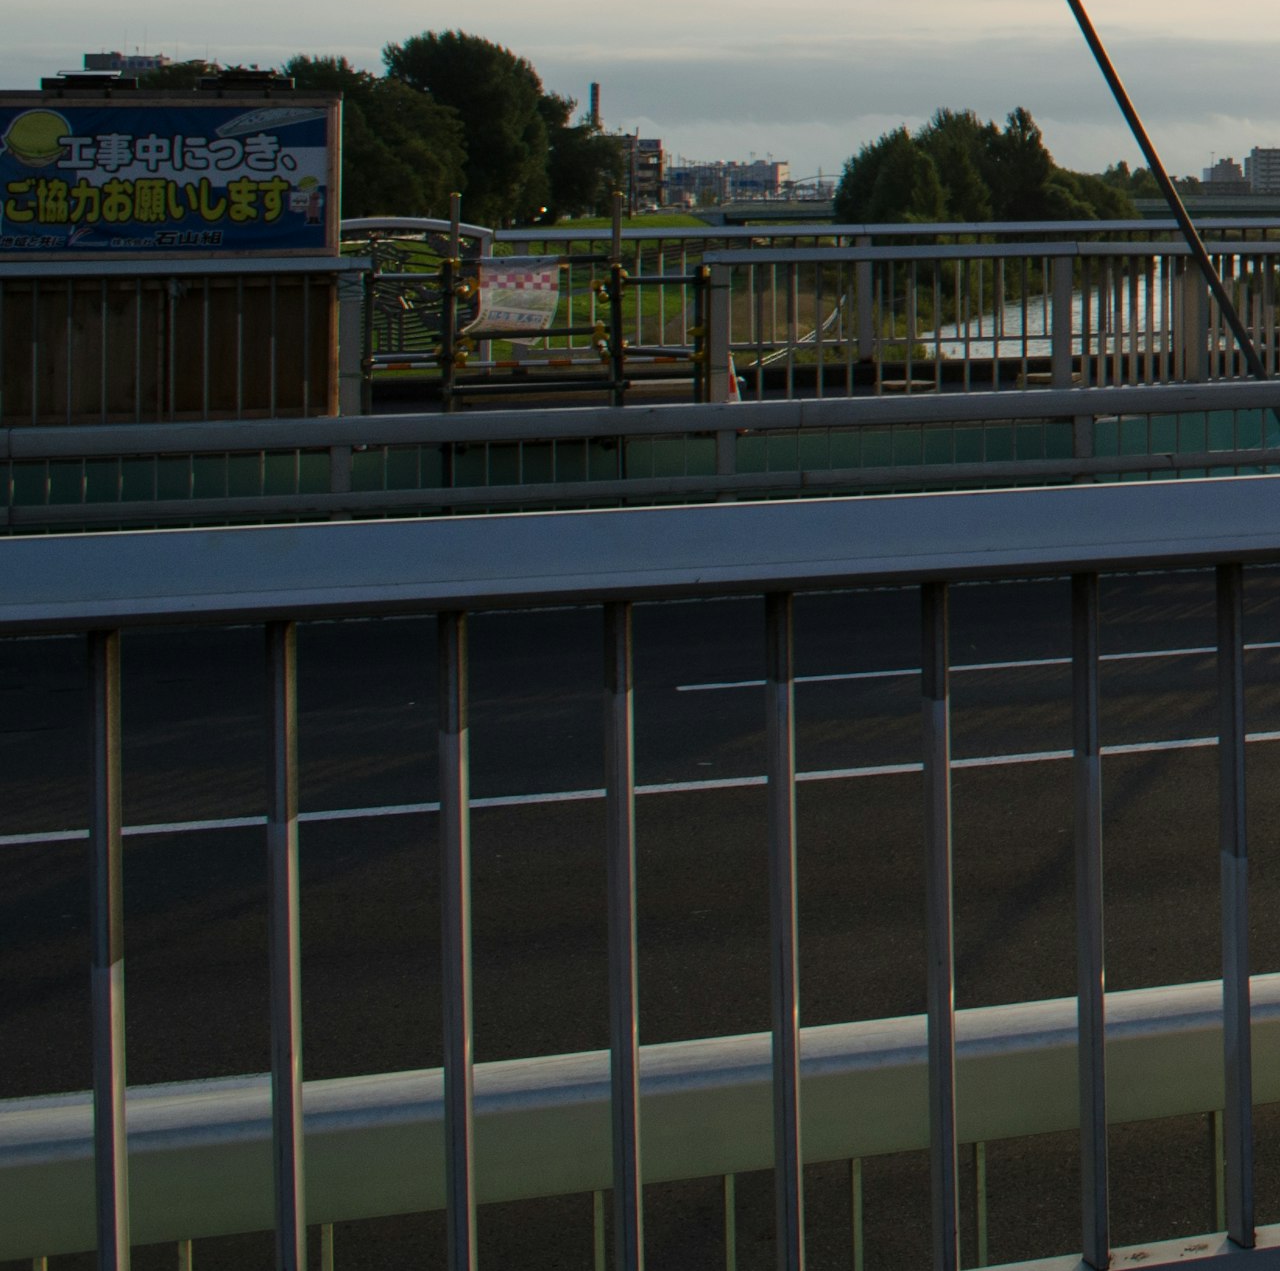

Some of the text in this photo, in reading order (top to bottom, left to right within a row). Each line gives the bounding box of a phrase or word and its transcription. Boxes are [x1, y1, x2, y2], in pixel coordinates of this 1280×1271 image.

[57, 133, 297, 172] 工事中につき、
[5, 176, 290, 224] ご協力お願いします
